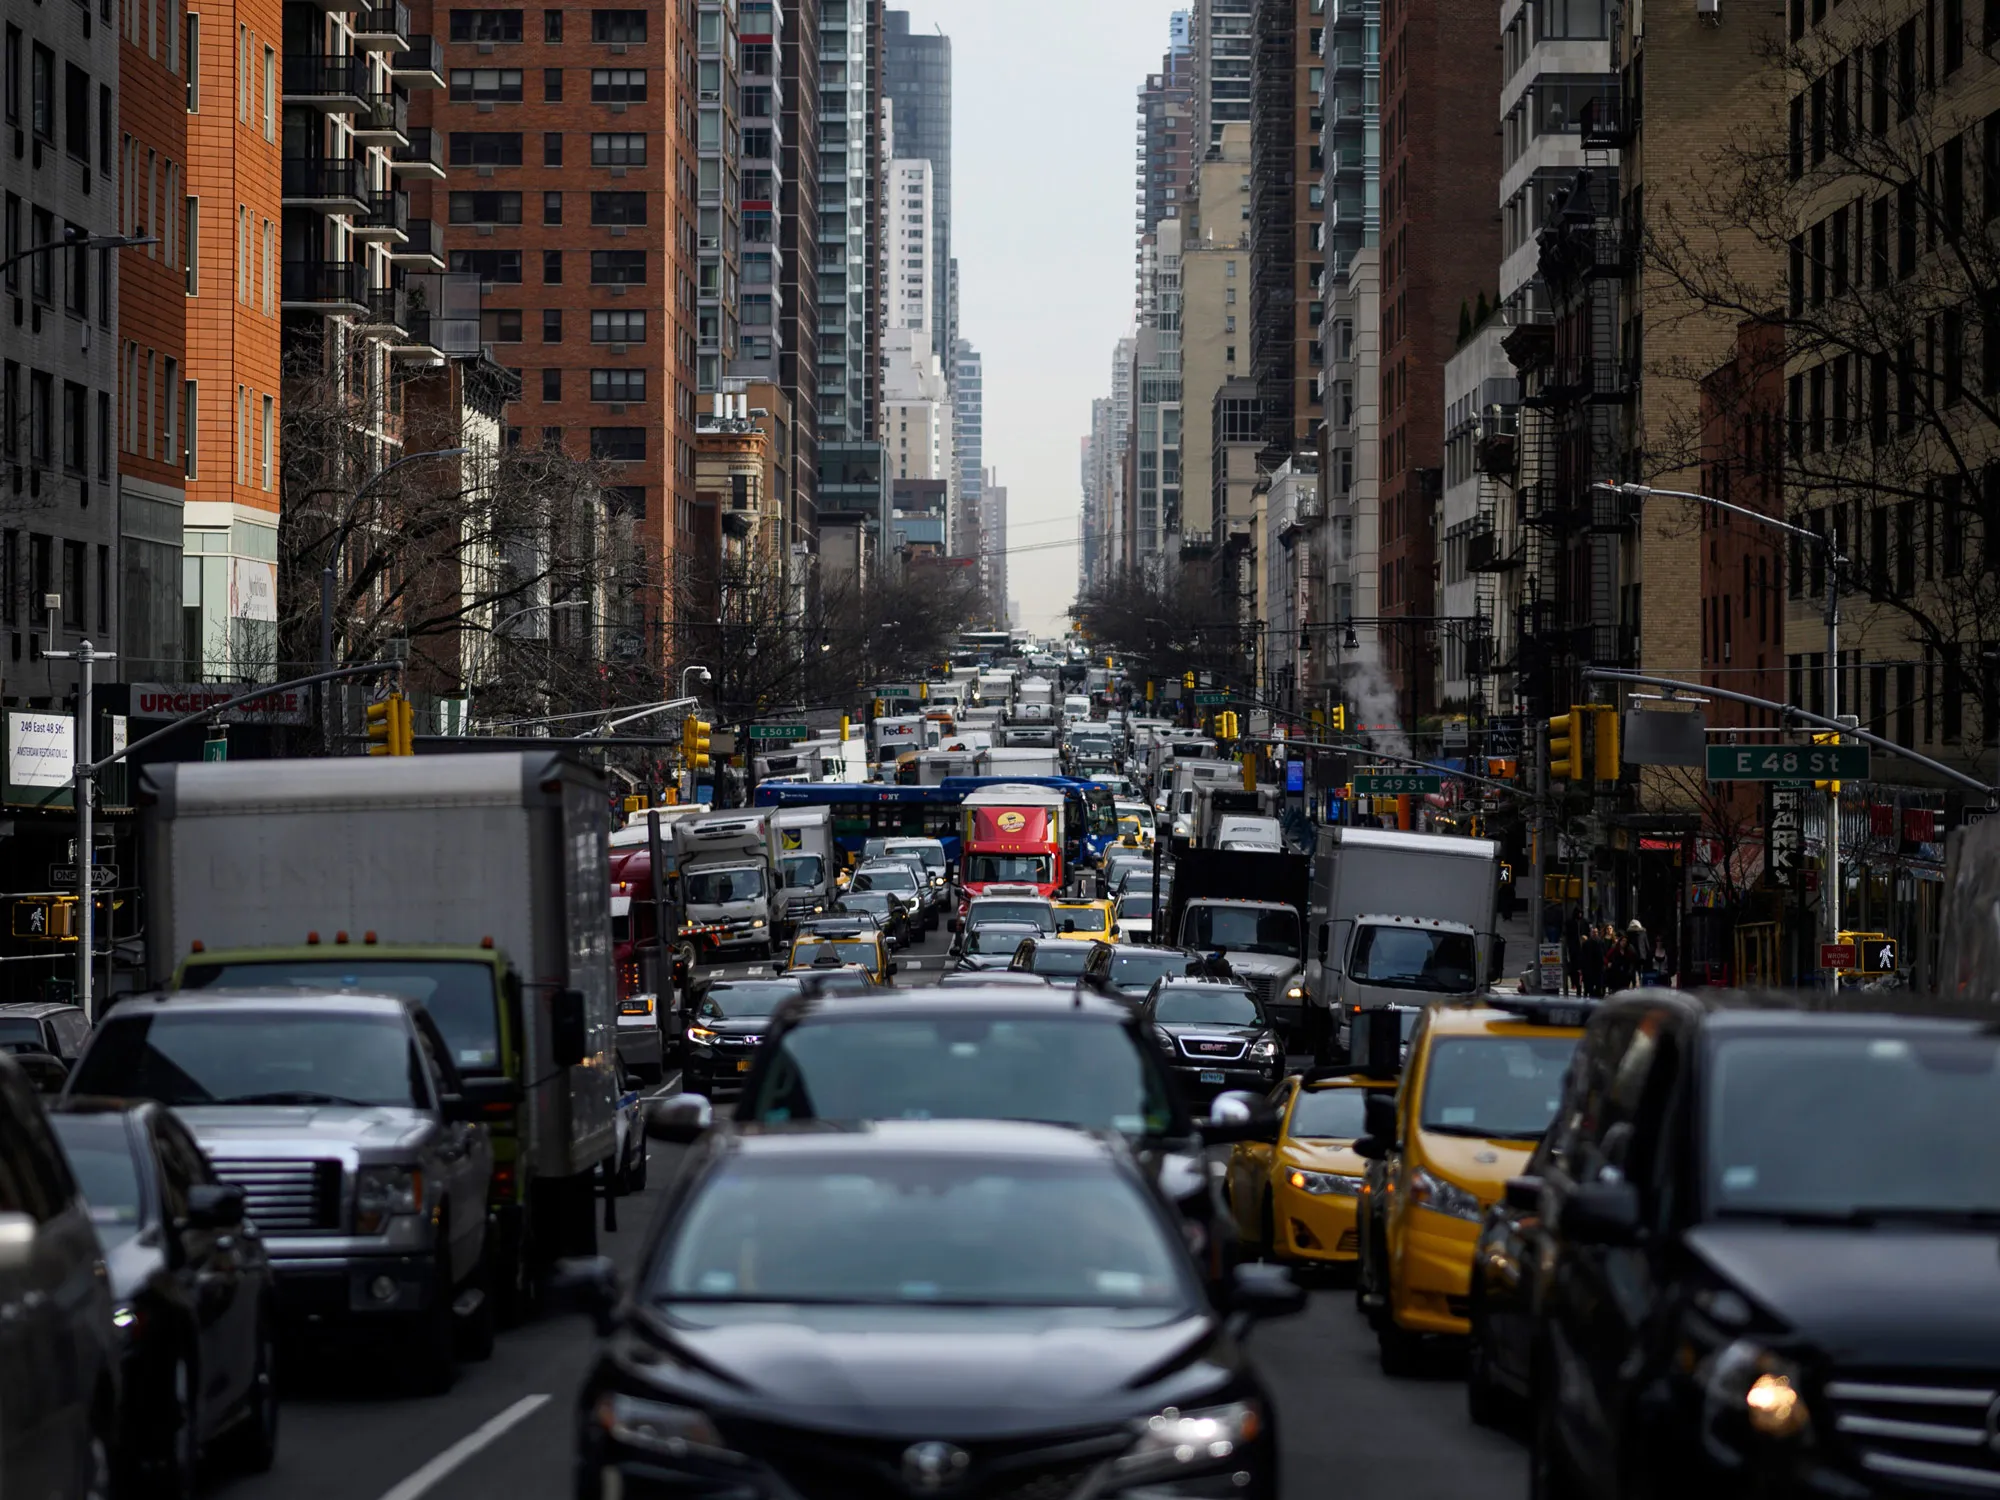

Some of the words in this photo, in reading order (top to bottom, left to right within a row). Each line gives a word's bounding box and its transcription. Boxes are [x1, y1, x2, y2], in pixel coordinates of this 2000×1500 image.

[140, 693, 232, 712] URGENT
[238, 693, 298, 712] CARE
[20, 720, 32, 732] 249
[33, 722, 45, 733] East
[46, 723, 54, 734] 48
[55, 723, 65, 734] Str.
[760, 728, 766, 736] E
[769, 728, 782, 736] 50
[785, 728, 797, 736] St
[883, 725, 914, 736] FedEx
[1737, 752, 1752, 773] E
[1761, 752, 1798, 773] 48
[1809, 752, 1840, 773] St
[1370, 779, 1379, 790] E
[1383, 779, 1403, 790] 49
[1408, 779, 1425, 790] St
[888, 793, 900, 801] NY
[1772, 792, 1798, 867] PARK
[56, 871, 77, 880] ONE
